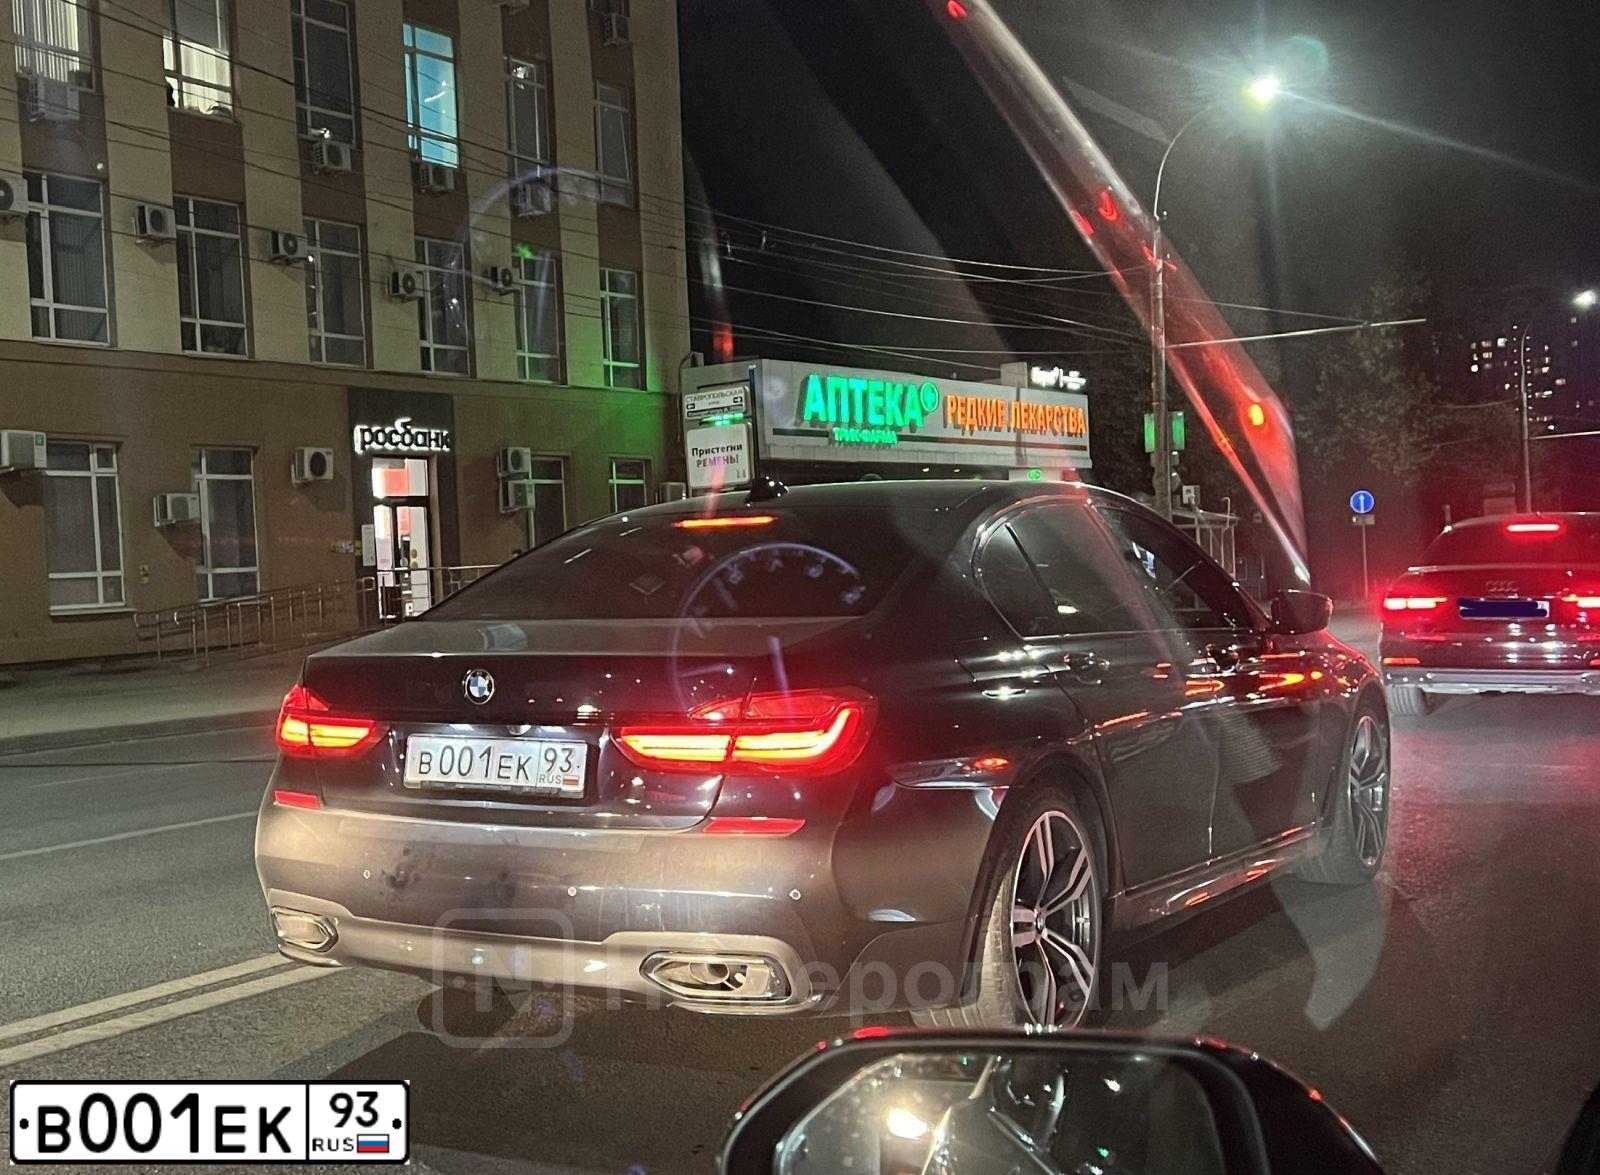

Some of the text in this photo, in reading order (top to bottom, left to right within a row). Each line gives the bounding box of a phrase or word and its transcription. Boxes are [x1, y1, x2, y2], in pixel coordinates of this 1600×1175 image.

[803, 374, 924, 428] АПТЕКА
[946, 395, 1087, 434] РЕДКИЕ ЛЕКАРСТВА
[356, 418, 451, 453] росбанк
[691, 444, 743, 457] Пристегни
[544, 748, 575, 772] 93
[539, 775, 562, 785] RUS
